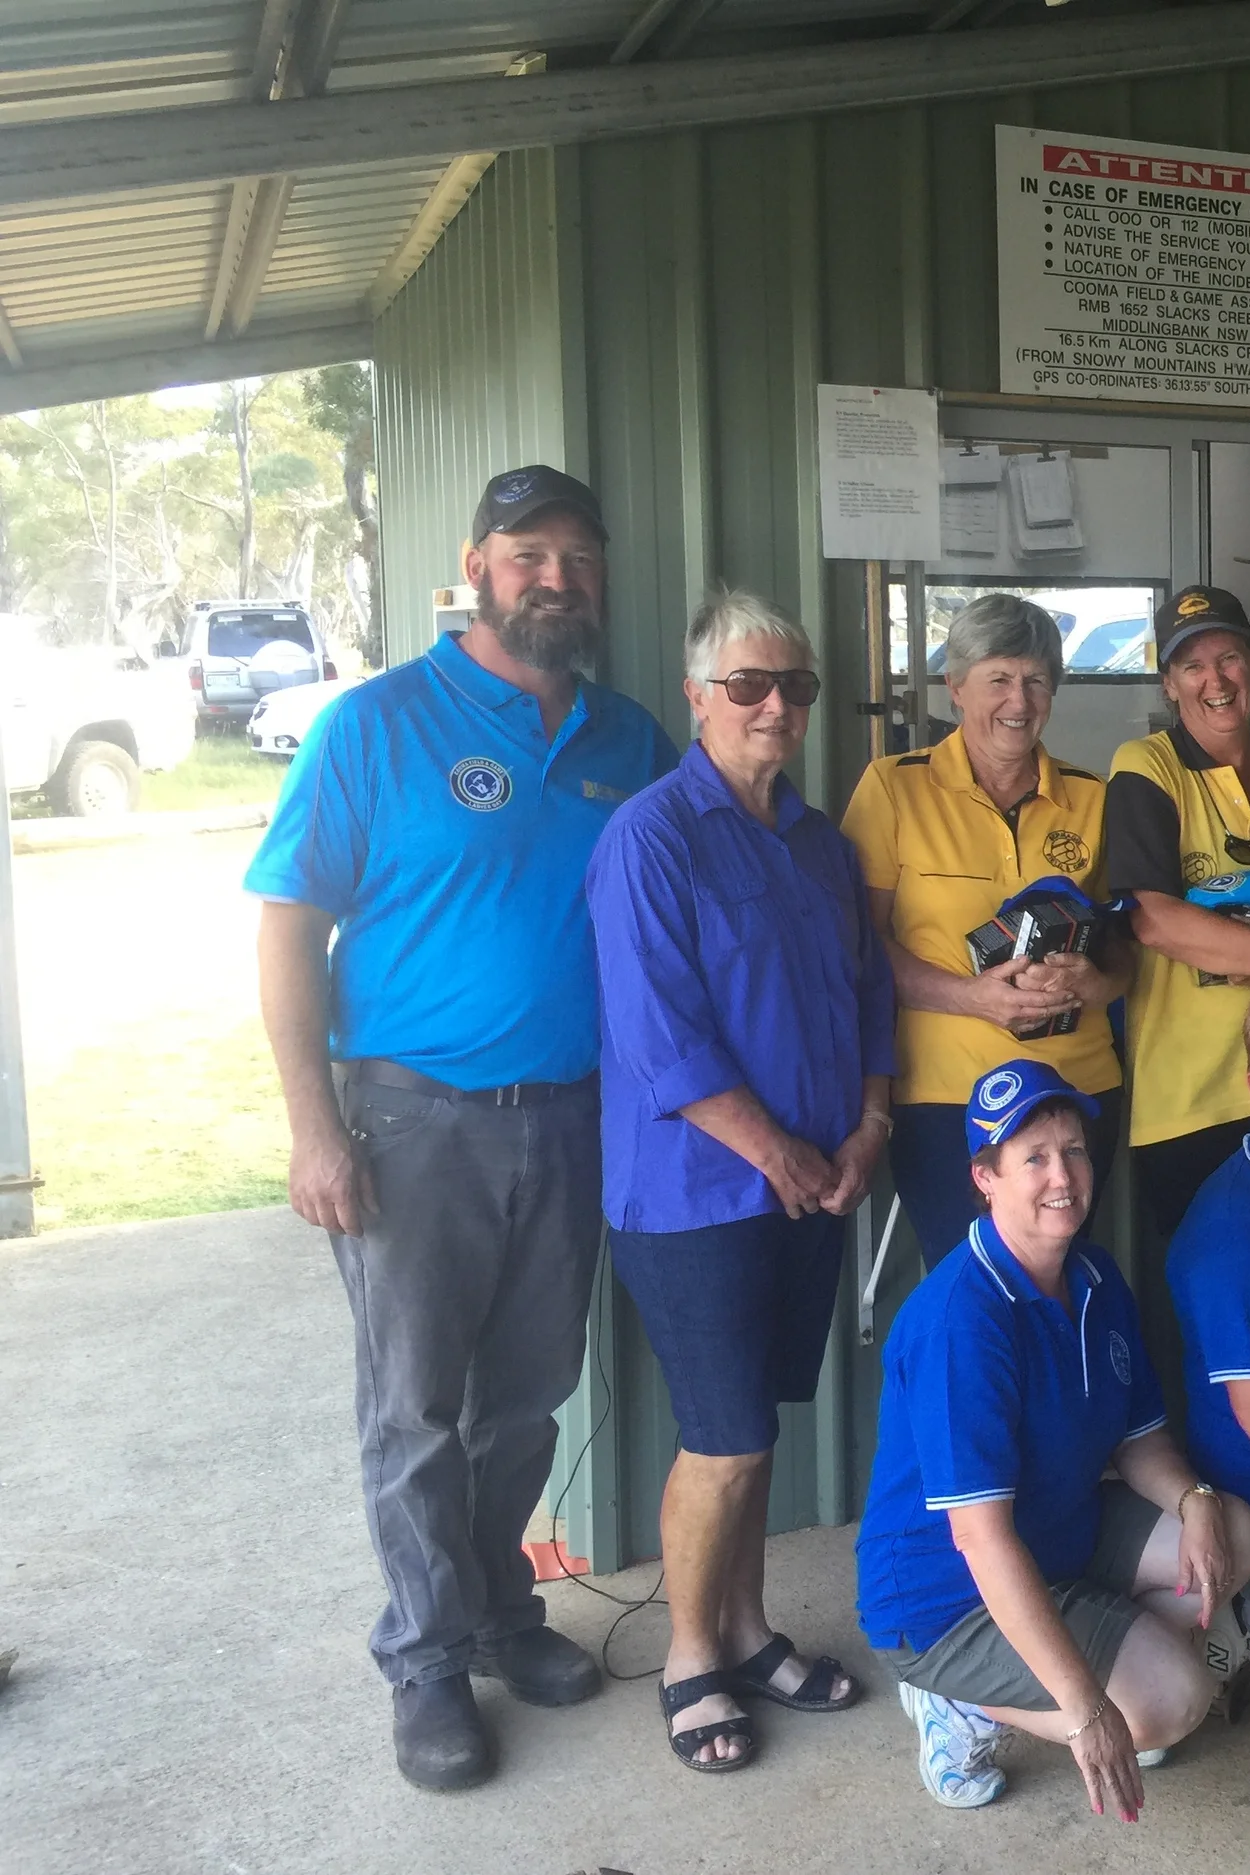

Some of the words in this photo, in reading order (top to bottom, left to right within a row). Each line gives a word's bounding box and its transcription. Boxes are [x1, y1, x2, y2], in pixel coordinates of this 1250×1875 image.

[1021, 177, 1038, 194] IN
[1049, 181, 1095, 200] CASE
[1106, 187, 1128, 203] OF
[1139, 191, 1241, 216] EMERGENCY
[1064, 206, 1100, 221] CALL
[1150, 216, 1170, 229] OR
[1182, 220, 1198, 232] 112
[1064, 224, 1115, 240] ADVISE
[1124, 230, 1152, 244] THE
[1161, 234, 1219, 251] SERVICE
[1065, 242, 1122, 259] NATURE
[1131, 249, 1150, 262] OF
[1159, 252, 1246, 271] EMERGENCY
[1065, 259, 1136, 277] LOCATION
[1146, 267, 1164, 280] OF
[1173, 270, 1200, 284] THE
[1064, 280, 1118, 297] COOMA
[1127, 286, 1165, 300] FIELD
[1170, 290, 1179, 302] &
[1184, 291, 1222, 306] GAME
[1079, 299, 1110, 313] RMB
[1120, 303, 1148, 316] 1652
[1157, 306, 1210, 321] SLACKS
[1103, 318, 1209, 338] MIDDLINGBANK
[1218, 328, 1248, 341] NSW
[1060, 334, 1084, 346] 16.5
[1090, 335, 1110, 348] Km
[1119, 338, 1166, 352] ALONG
[1176, 342, 1228, 357] SLACKS
[1016, 348, 1064, 364] (FROM
[1074, 352, 1125, 368] SNOWY
[1134, 357, 1216, 374] MOUNTAINS
[1034, 371, 1059, 383] GPS
